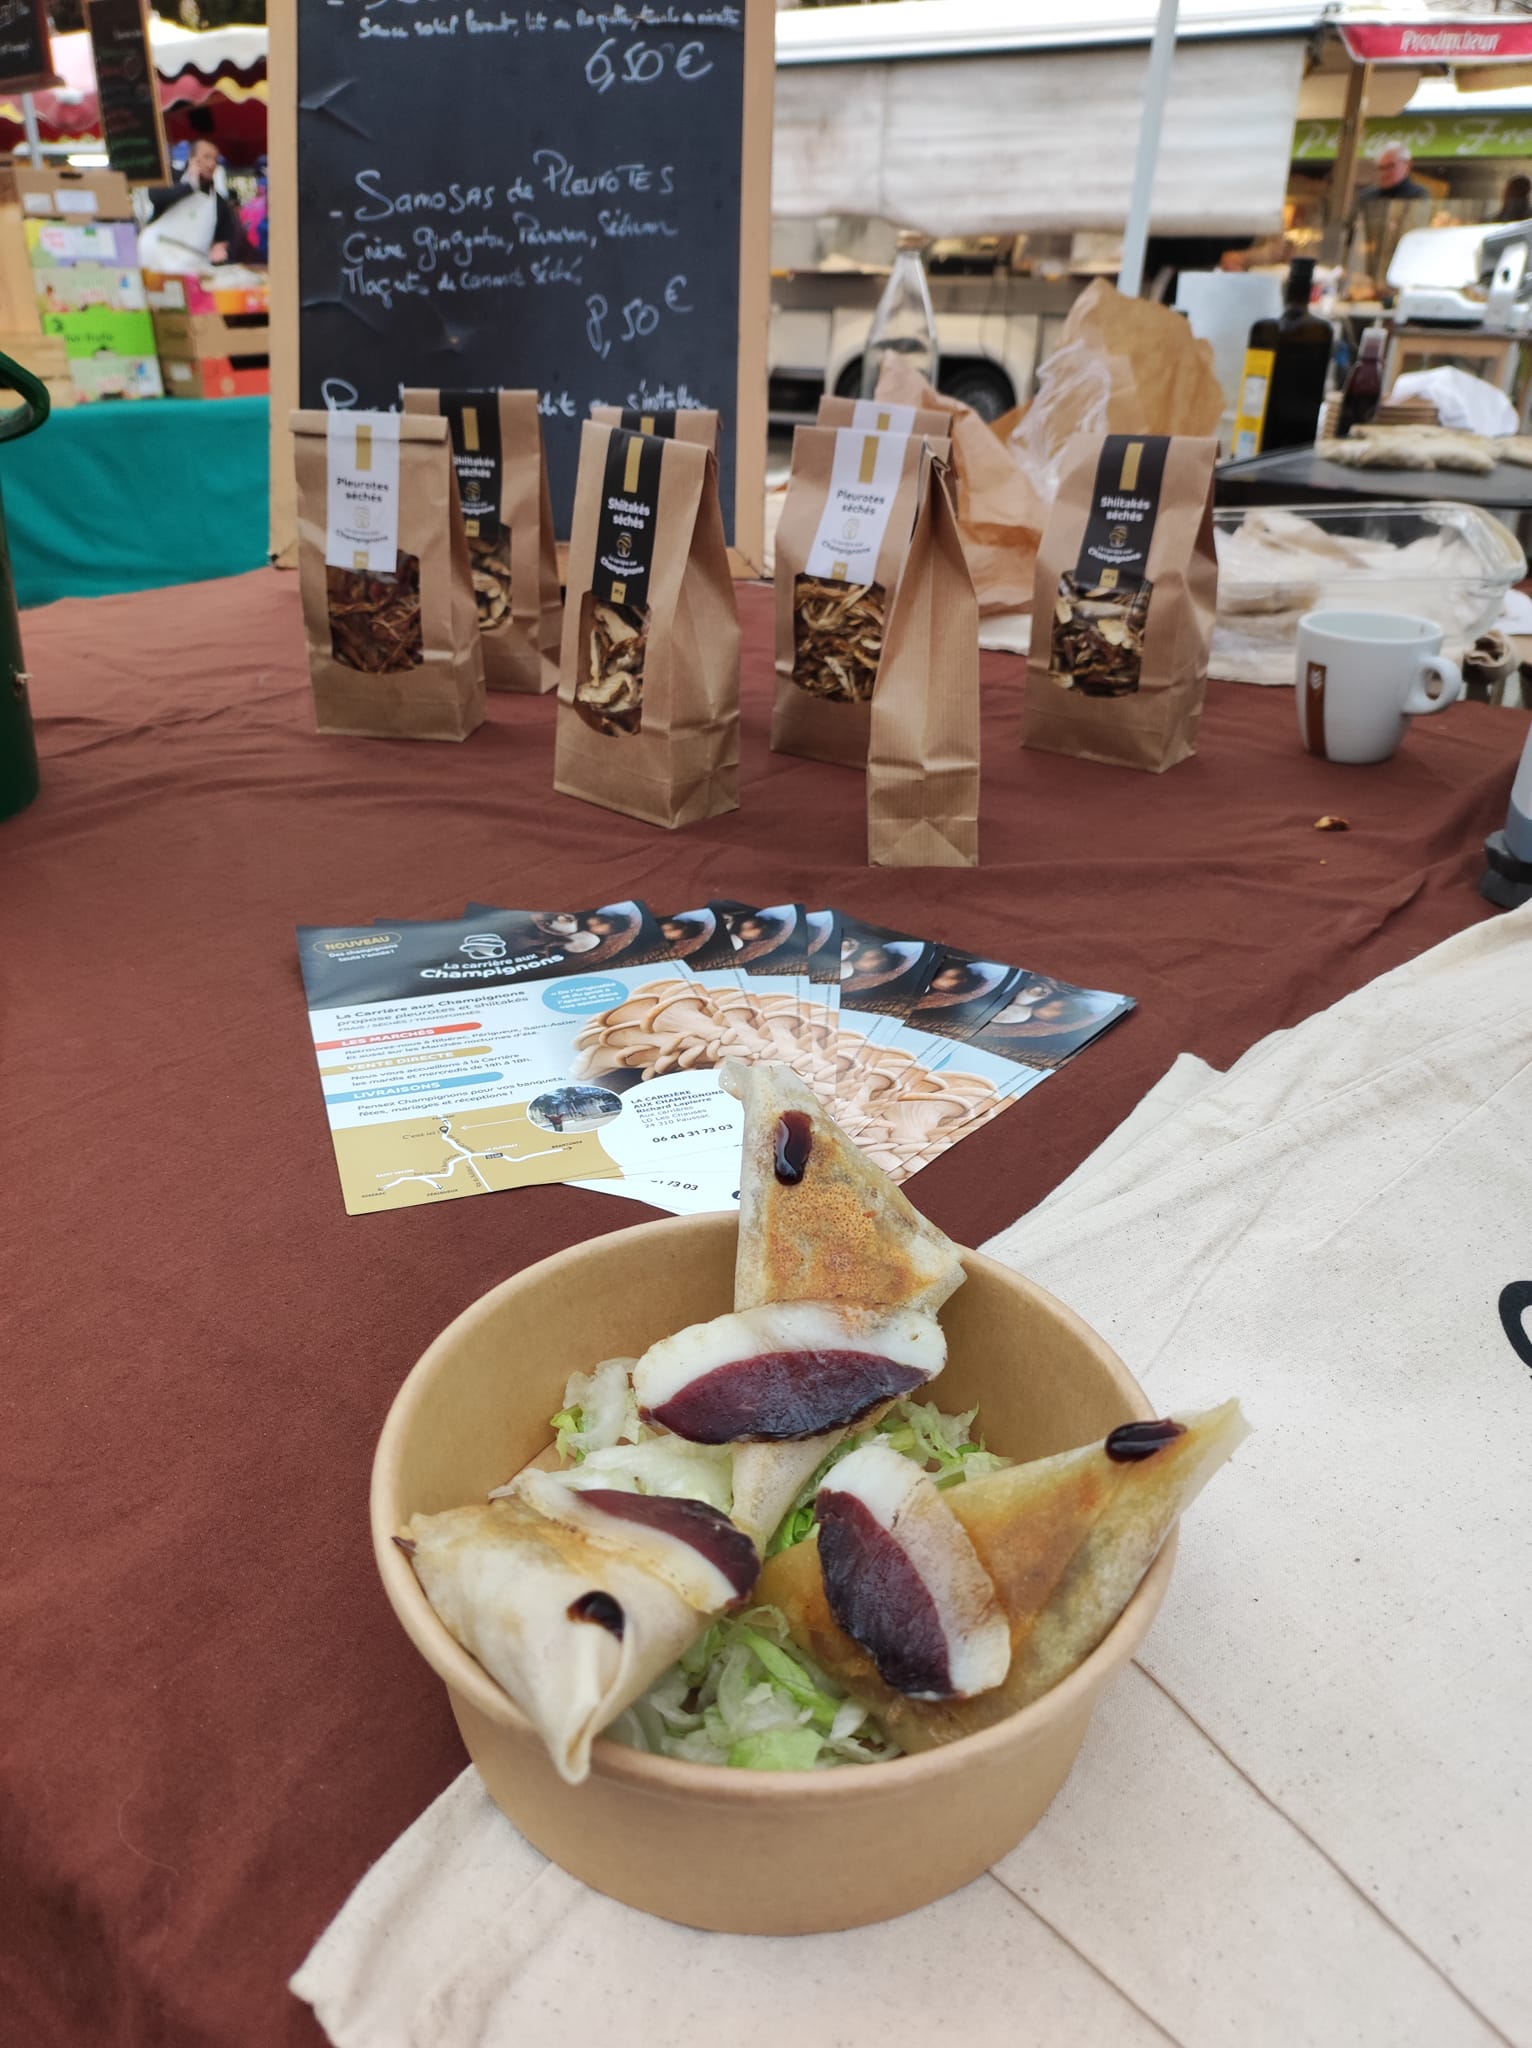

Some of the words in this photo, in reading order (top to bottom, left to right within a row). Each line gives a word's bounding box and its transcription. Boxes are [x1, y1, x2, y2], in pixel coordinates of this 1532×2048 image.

[585, 38, 664, 93] 6,50
[675, 41, 713, 80] €
[664, 274, 694, 312] €
[336, 477, 389, 492] Pleurotes
[345, 491, 382, 503] séchés
[836, 489, 886, 505] Pleurotes
[842, 504, 876, 516] séchés
[1105, 510, 1144, 522] séchés
[612, 513, 645, 530] séchés
[325, 935, 390, 951] NOUVEAU
[420, 954, 565, 979] Champignons
[443, 962, 455, 970] La
[458, 957, 513, 969] carrière
[515, 953, 539, 963] aux
[337, 1015, 392, 1027] propose
[395, 1007, 455, 1020] pleurotes
[474, 997, 529, 1009] shiitakés
[355, 1006, 408, 1017] Carrière
[438, 990, 526, 1007] Champignons
[341, 1038, 367, 1047] LES
[369, 1029, 436, 1042] MARCHÉS
[464, 1035, 512, 1045] nocturnes
[347, 1059, 394, 1071] VENTE
[396, 1051, 455, 1065] DIRECTE
[407, 1062, 461, 1074] accueillons
[481, 1053, 520, 1063] Carrière
[369, 1076, 405, 1085] mardis
[419, 1066, 469, 1078] mercredis
[353, 1081, 441, 1100] LIVRAISONS
[358, 1101, 395, 1111] Pensez
[398, 1091, 469, 1105] Champignons
[470, 1087, 494, 1096] pour
[516, 1077, 567, 1088] banquets,
[633, 1101, 653, 1109] AUX
[655, 1089, 725, 1105] CHAMPIGNONS
[645, 1090, 692, 1102] CARRIÈRE
[359, 1109, 389, 1117] fêtes,
[391, 1102, 440, 1113] mariages
[454, 1092, 508, 1104] réceptions
[636, 1103, 672, 1114] Richard
[674, 1097, 712, 1107] Lapierre
[670, 1132, 685, 1140] 44
[718, 1123, 734, 1131] 03
[682, 1183, 699, 1191] 03
